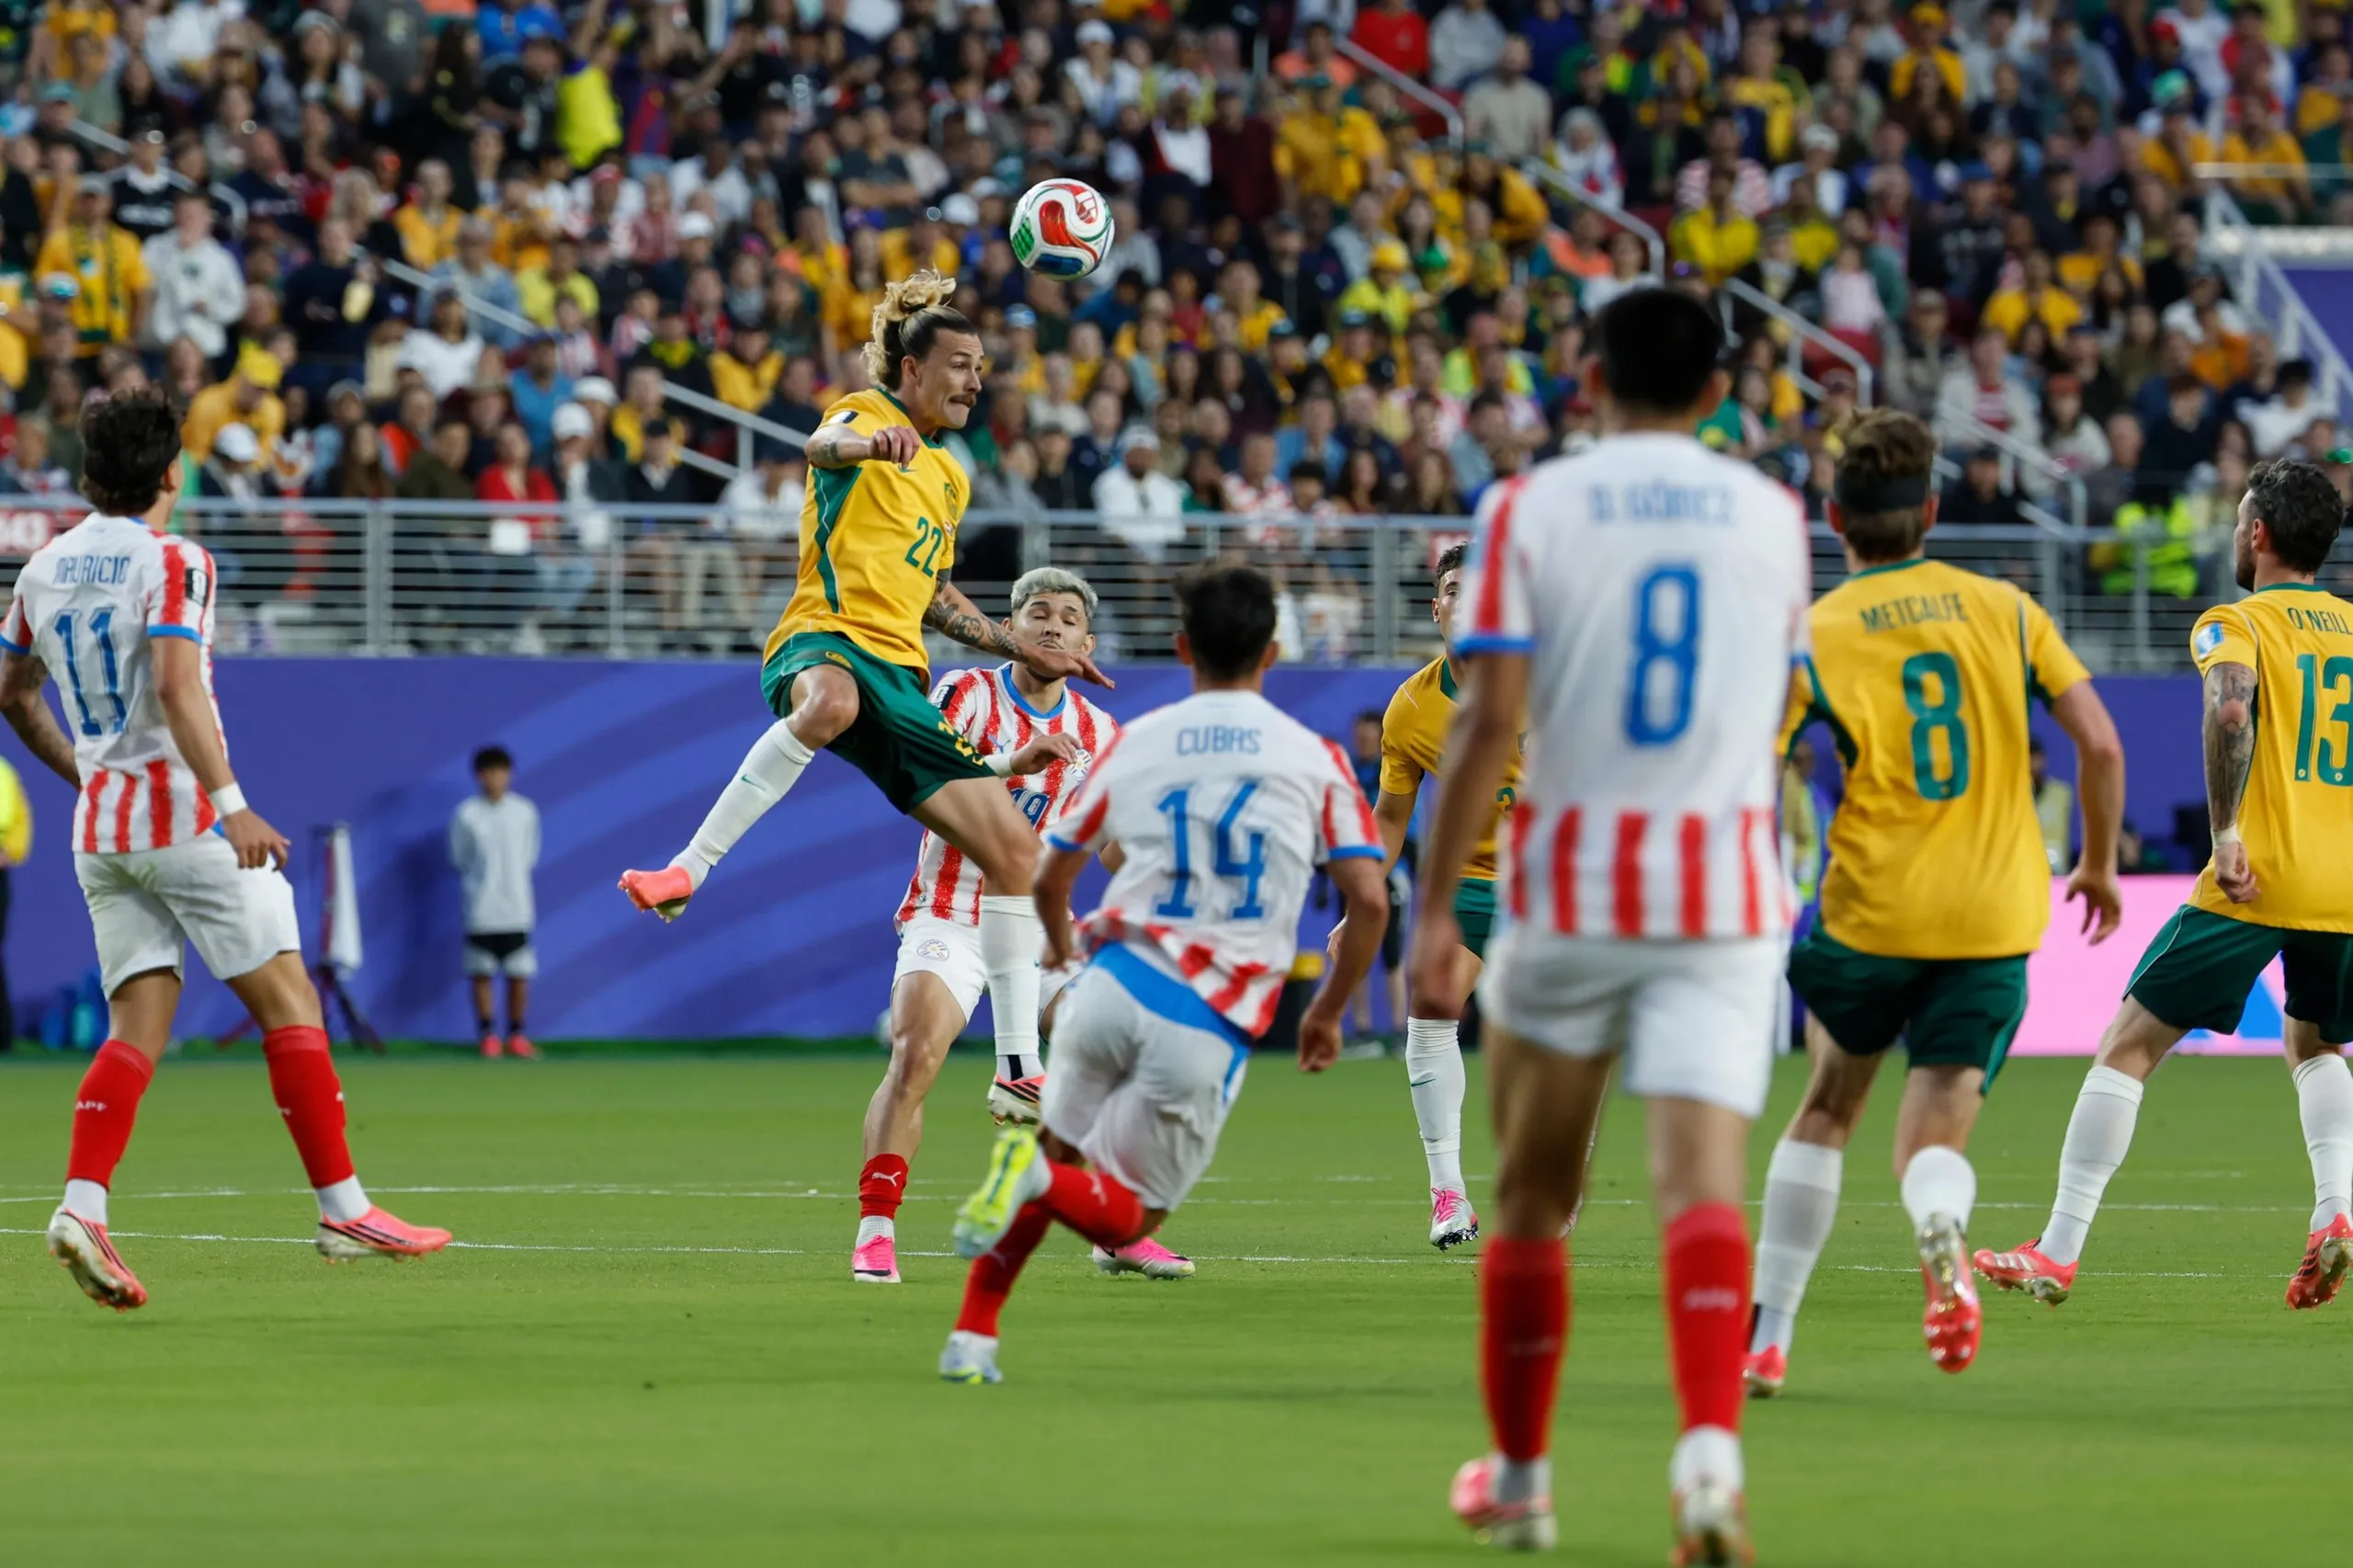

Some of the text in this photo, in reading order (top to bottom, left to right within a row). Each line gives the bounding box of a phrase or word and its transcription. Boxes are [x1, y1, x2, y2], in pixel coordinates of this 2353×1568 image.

[53, 555, 130, 585] MAURICIO
[904, 517, 942, 578] 22
[1623, 560, 1702, 747] 8
[1859, 593, 1968, 634] METCALFE
[2288, 608, 2353, 635] O'NEILL
[53, 608, 127, 738] 11
[2294, 653, 2353, 787] 13
[1176, 724, 1262, 756] CUBAS
[1902, 651, 1969, 801] 8
[1154, 776, 1272, 920] 14
